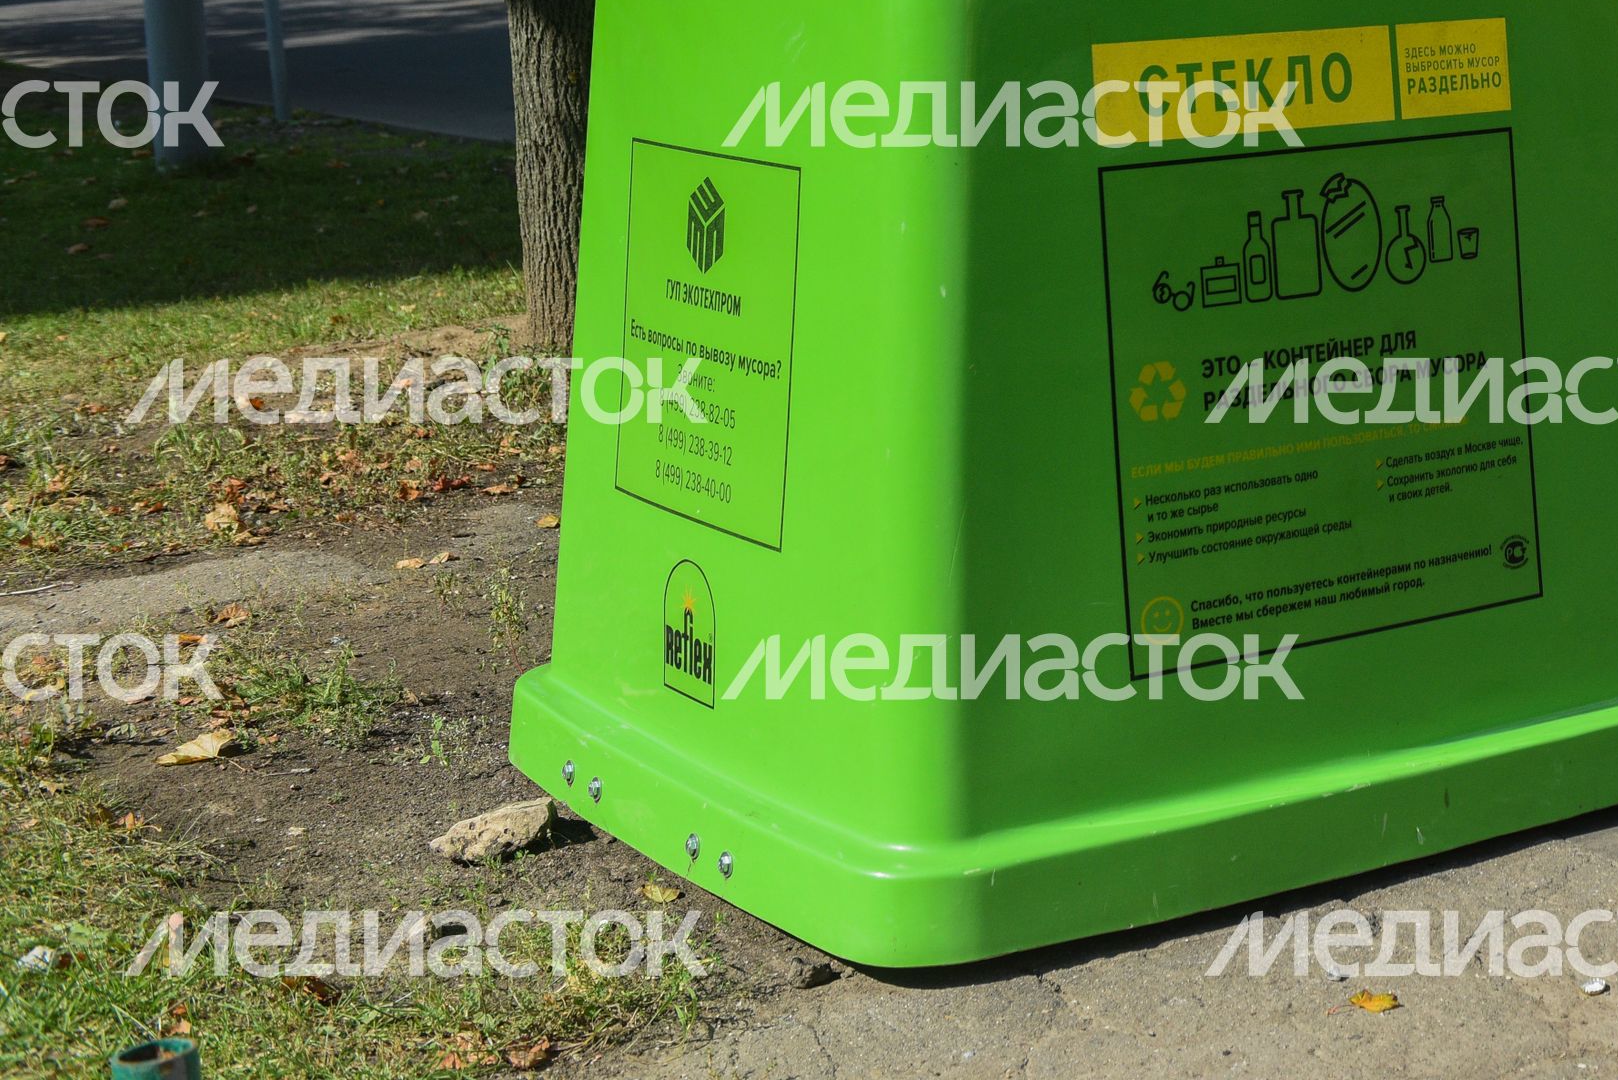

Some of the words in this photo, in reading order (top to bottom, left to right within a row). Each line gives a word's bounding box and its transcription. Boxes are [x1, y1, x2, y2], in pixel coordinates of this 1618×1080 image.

[1404, 46, 1436, 59] ЗДЕСЬ
[1439, 43, 1476, 56] МОЖНО
[1405, 58, 1464, 73] ВЫБРОСИТЬ
[1467, 55, 1500, 69] МУСОР
[1138, 51, 1353, 117] СТЕКЛО
[1407, 71, 1502, 95] РАЗДЕЛЬНО
[666, 279, 681, 302] ГУП
[682, 284, 741, 317] ЭКОТЕХПРОМ
[631, 319, 646, 341] Есть
[648, 329, 684, 353] вопросы
[686, 340, 697, 357] по
[699, 345, 736, 371] вывозу
[738, 355, 782, 382] мусора?
[1202, 355, 1241, 379] ЭТО
[1263, 336, 1375, 370] КОНТЕЙНЕР
[1380, 330, 1418, 356] ДЛЯ
[678, 364, 715, 392] Звоните:
[1203, 372, 1349, 411] РАЗДЕЛЬНОГО
[1352, 363, 1412, 390] СБОРА
[1416, 351, 1488, 379] МУСОРА
[666, 392, 688, 417] (499)
[665, 427, 686, 456] (499)
[688, 433, 733, 466] 238-39-12
[1385, 454, 1423, 469] Сделать
[1424, 447, 1456, 461] воздух
[1456, 446, 1463, 456] в
[1464, 440, 1497, 454] Москве
[1498, 436, 1524, 448] чище,
[662, 461, 683, 491] (499)
[685, 469, 732, 504] 238-40-00
[1145, 489, 1202, 507] Несколько
[1203, 486, 1222, 499] раз
[1224, 475, 1293, 494] использовать
[1294, 470, 1319, 483] одно
[1386, 471, 1434, 487] Сохранить
[1436, 463, 1478, 479] экологию
[1479, 459, 1496, 473] для
[1497, 454, 1517, 468] себя
[1388, 494, 1395, 503] и
[1396, 489, 1423, 502] своих
[1424, 482, 1450, 498] детей.
[1147, 513, 1154, 523] и
[1156, 510, 1168, 521] то
[1170, 508, 1185, 519] же
[1186, 502, 1219, 517] сырье
[1148, 526, 1204, 543] Экономить
[1206, 515, 1263, 535] природные
[1264, 508, 1307, 525] ресурсы
[1148, 547, 1200, 564] Улучшить
[1201, 537, 1254, 554] состояние
[1255, 523, 1320, 545] окружающей
[1321, 519, 1352, 535] среды
[1190, 593, 1243, 613] Спасибо,
[1245, 590, 1264, 602] что
[1266, 578, 1335, 599] пользуетесь
[1336, 563, 1412, 585] контейнерами
[1413, 559, 1426, 570] по
[1428, 544, 1492, 567] назначению!
[1191, 614, 1233, 630] Вместе
[1235, 610, 1254, 622] мы
[1256, 599, 1312, 618] сбережем
[1314, 594, 1337, 607] наш
[1339, 582, 1391, 602] любимый
[1392, 577, 1425, 592] город.
[665, 607, 713, 685] Reflex
